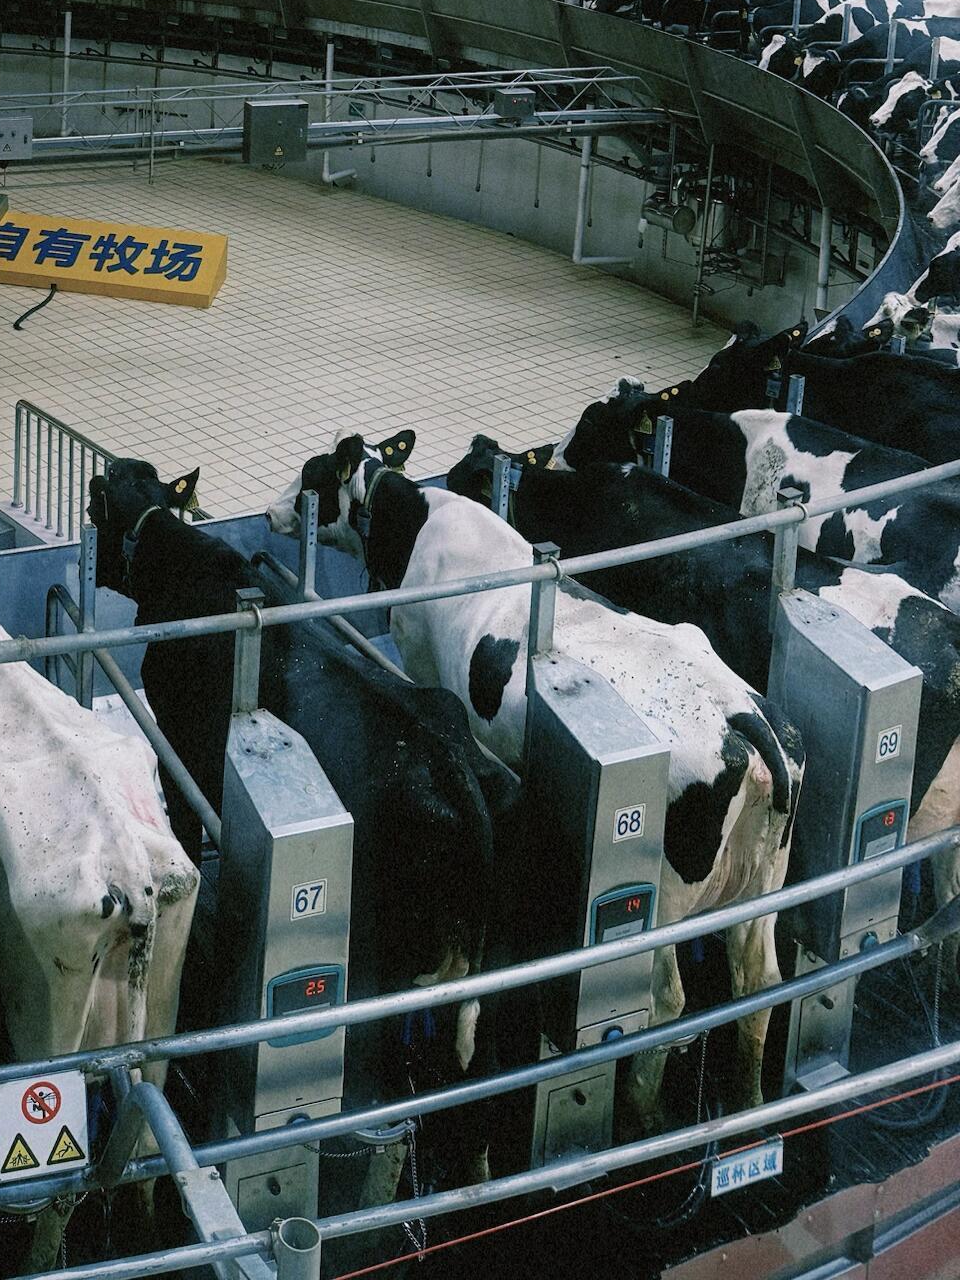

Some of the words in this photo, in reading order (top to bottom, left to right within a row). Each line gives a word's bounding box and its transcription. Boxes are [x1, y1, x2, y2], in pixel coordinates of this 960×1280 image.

[880, 732, 897, 756] 69
[618, 810, 640, 835] 68
[295, 885, 322, 913] 67
[306, 980, 325, 996] 2.5
